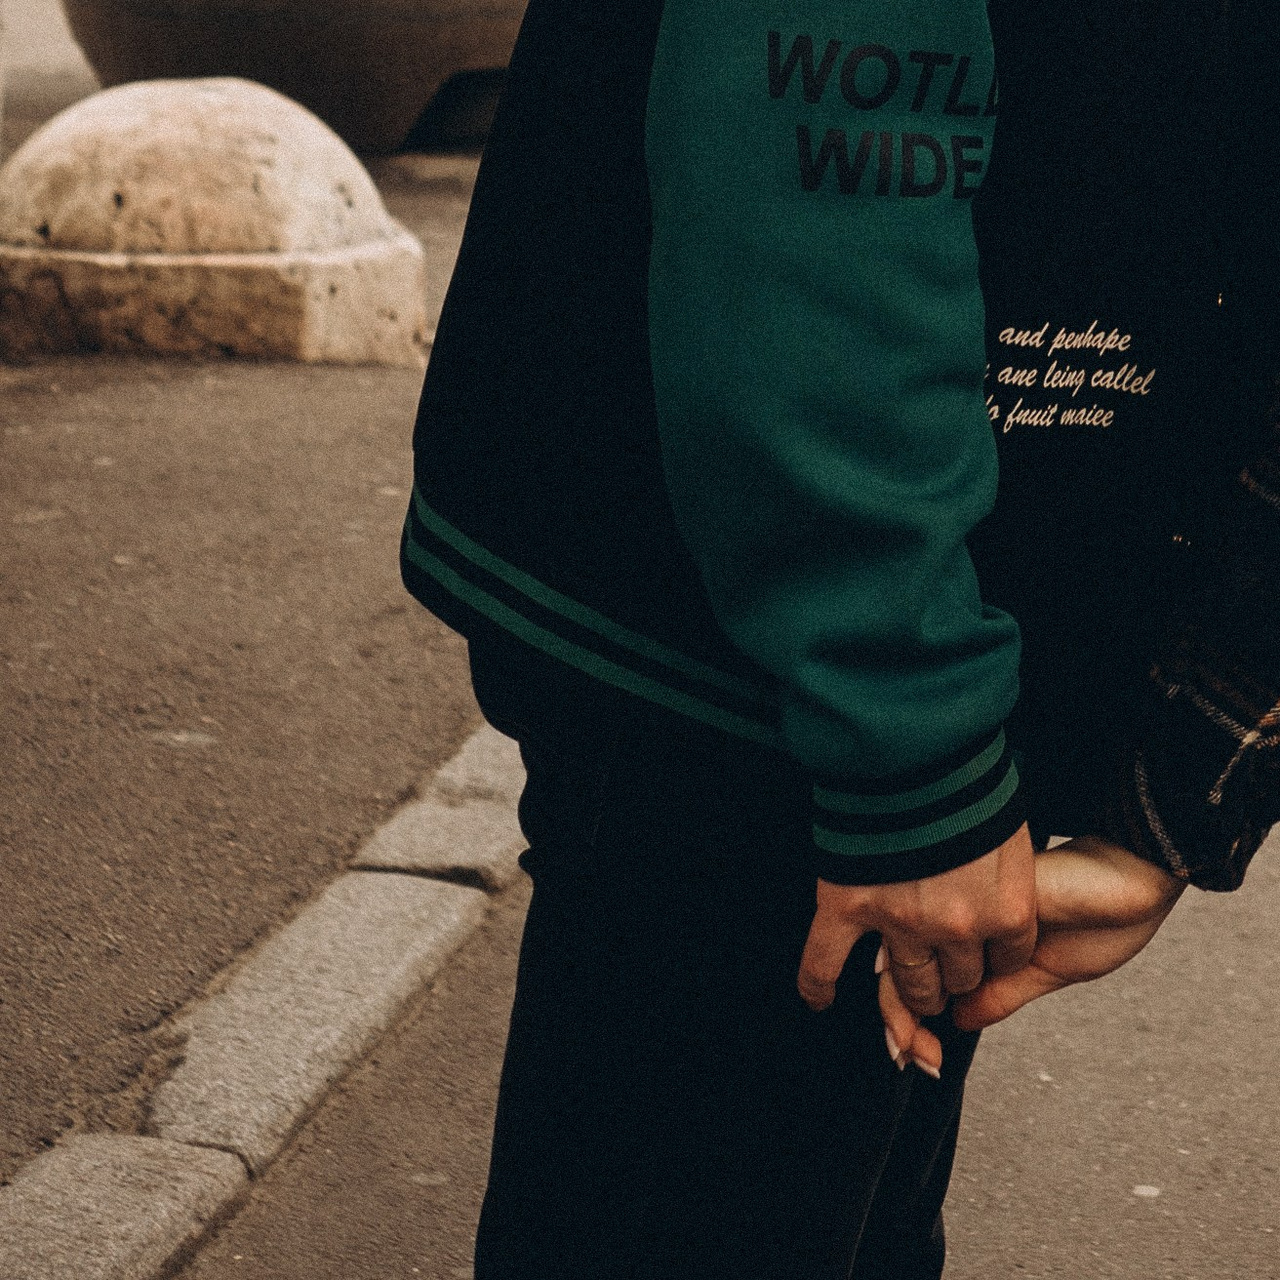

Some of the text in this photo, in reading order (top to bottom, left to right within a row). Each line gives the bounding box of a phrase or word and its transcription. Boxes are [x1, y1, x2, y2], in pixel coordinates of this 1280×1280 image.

[767, 30, 999, 117] WOTL
[795, 124, 984, 200] WIDE
[998, 321, 1050, 348] and
